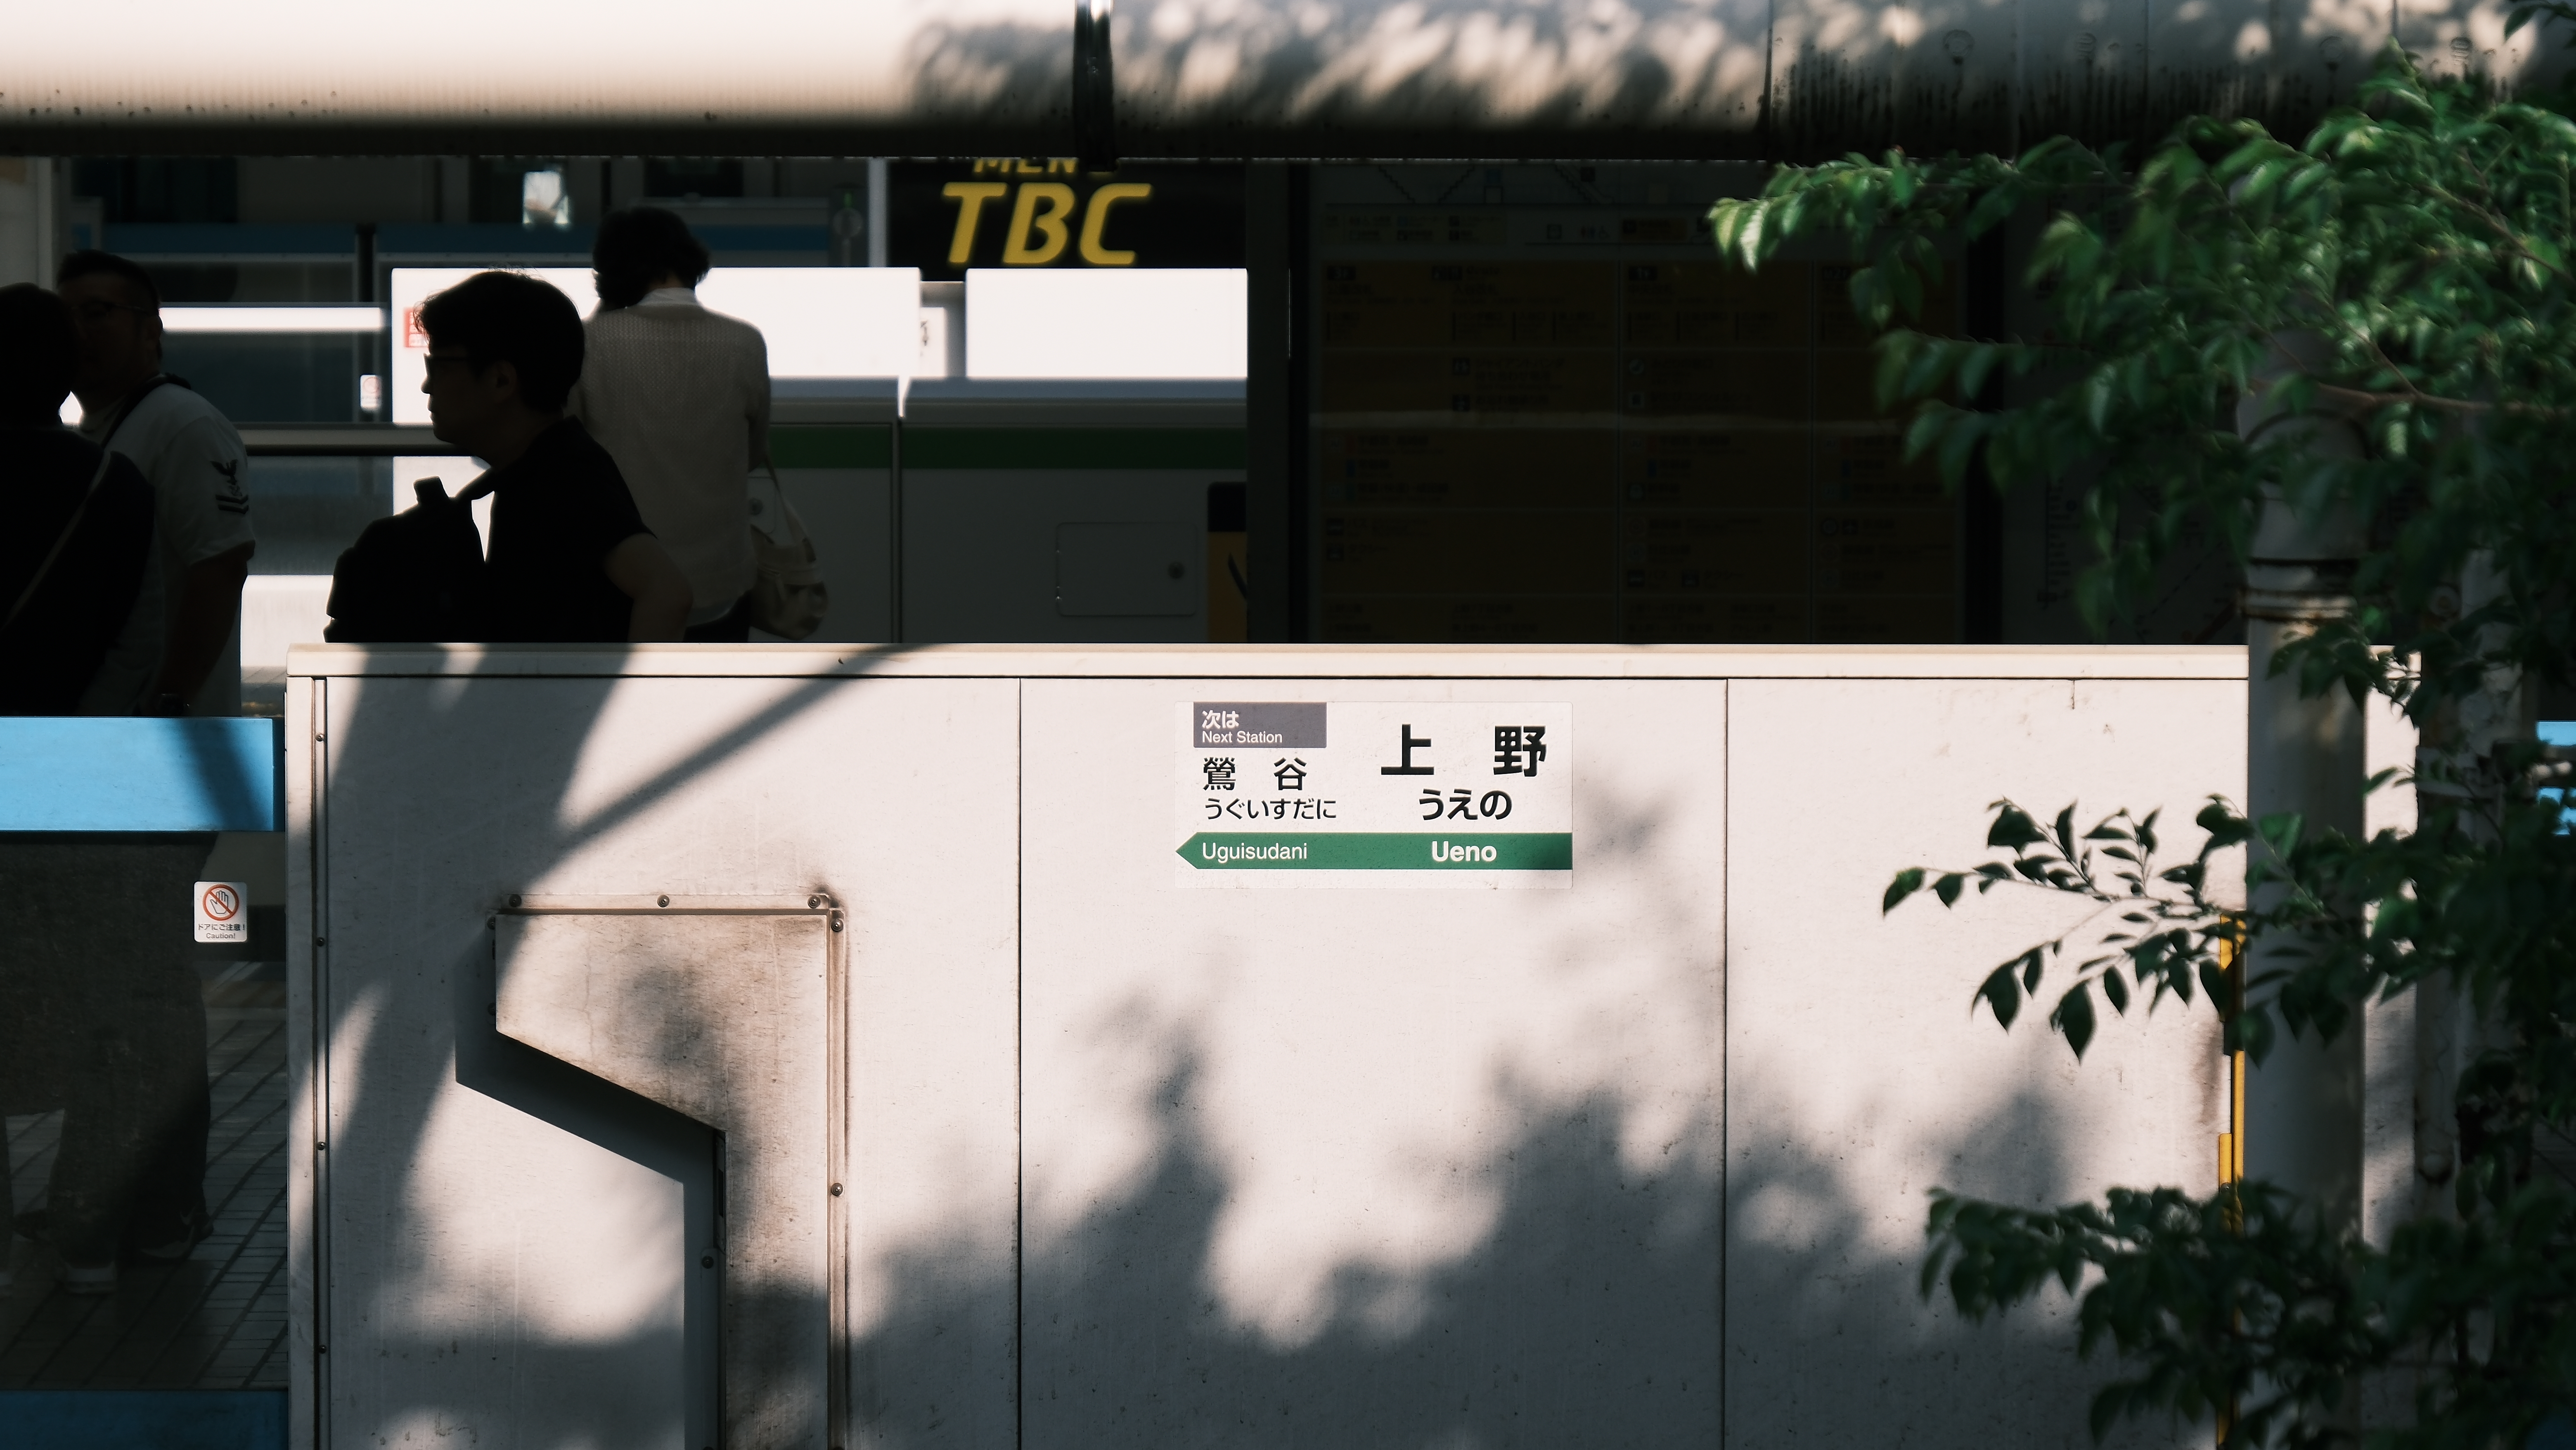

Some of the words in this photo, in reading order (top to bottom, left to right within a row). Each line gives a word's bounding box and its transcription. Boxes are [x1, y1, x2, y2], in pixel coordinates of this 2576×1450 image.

[942, 182, 1152, 266] TBC
[1201, 709, 1240, 730] 次は
[1202, 730, 1233, 744] Next
[1236, 730, 1283, 744] Station
[1380, 724, 1547, 777] 上野
[1203, 757, 1308, 791] 鶯谷
[1205, 798, 1337, 820] うぐいすだに
[1418, 788, 1513, 821] うえの
[1202, 842, 1308, 863] Uguisudani
[1431, 840, 1498, 862] Ueno
